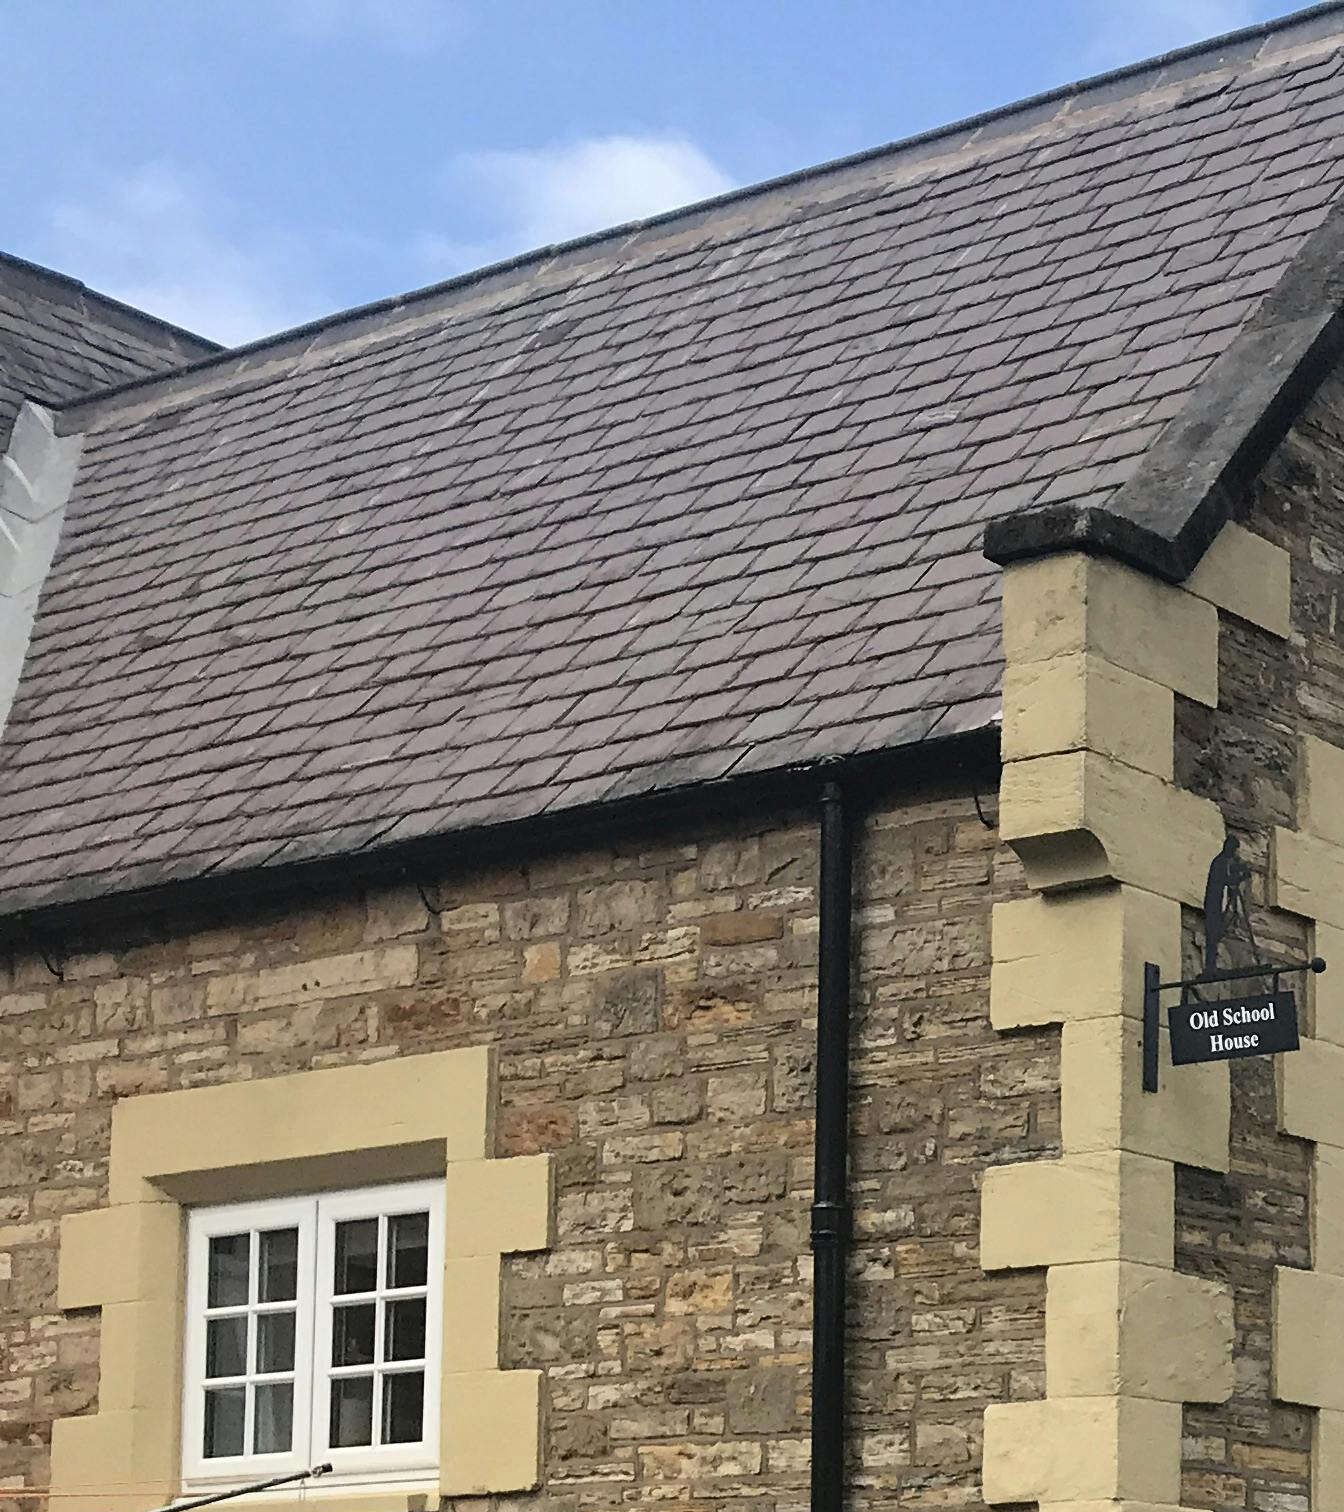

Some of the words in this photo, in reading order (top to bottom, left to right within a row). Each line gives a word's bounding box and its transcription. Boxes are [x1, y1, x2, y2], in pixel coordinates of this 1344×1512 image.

[1189, 1010, 1219, 1030] Old
[1223, 1002, 1275, 1027] School
[1210, 1034, 1260, 1053] House
